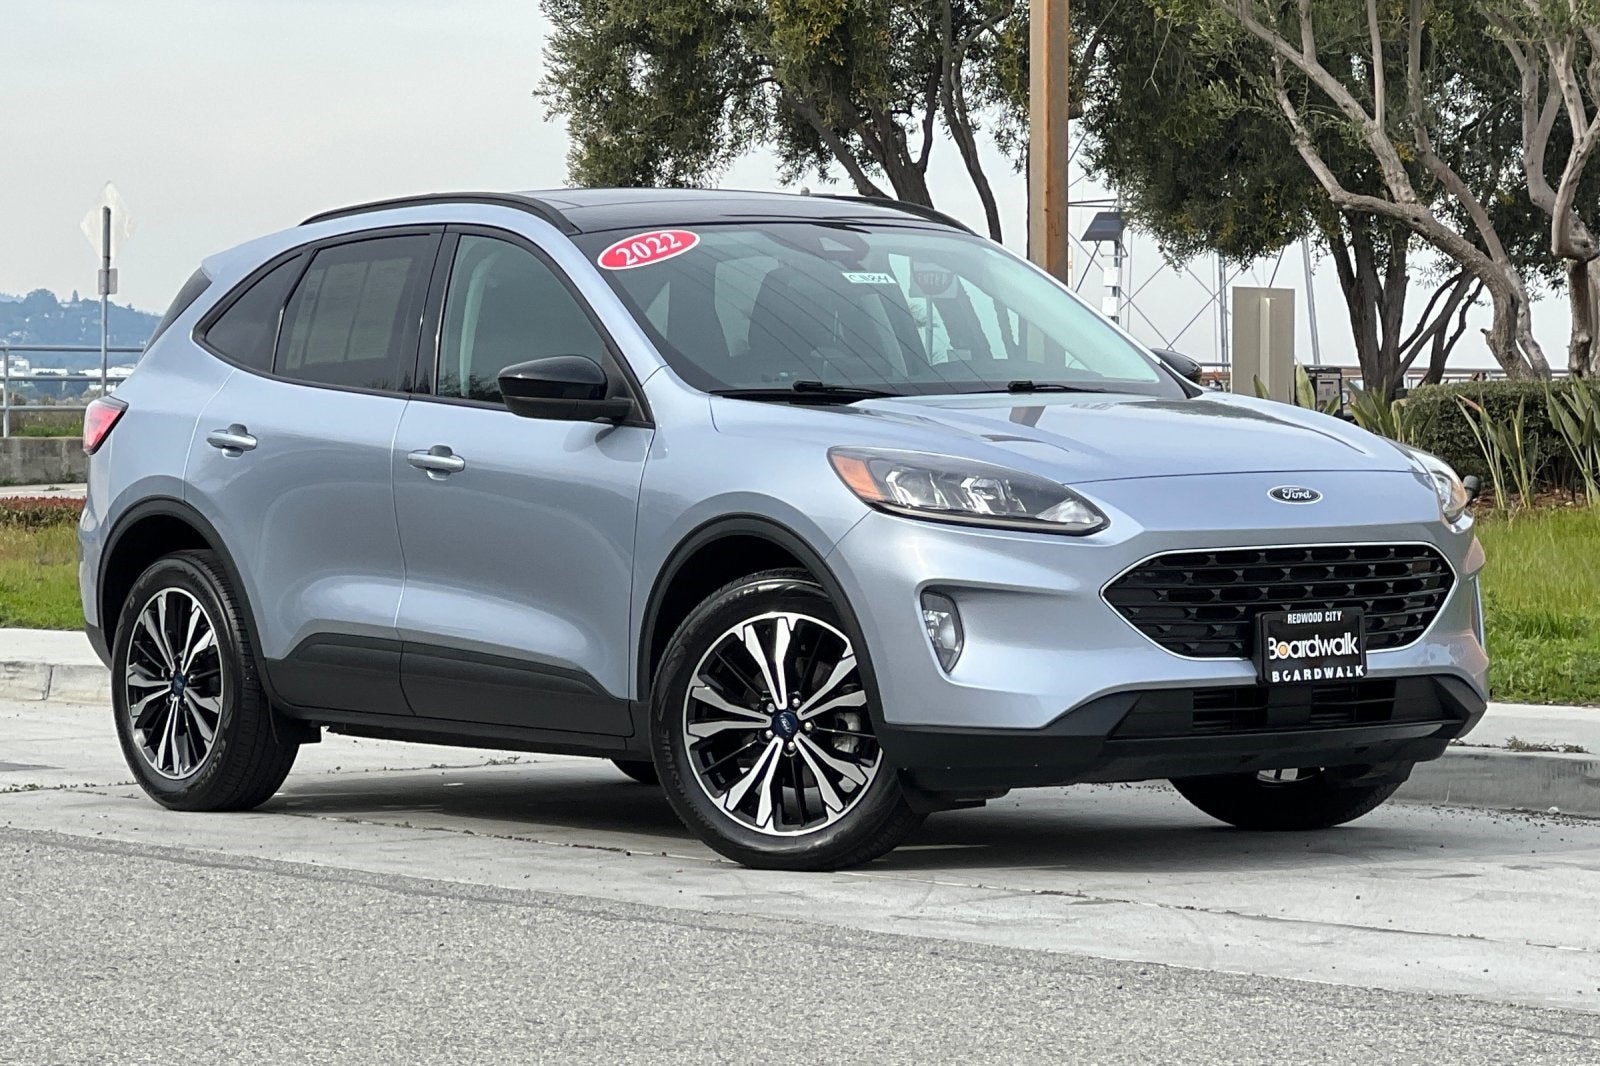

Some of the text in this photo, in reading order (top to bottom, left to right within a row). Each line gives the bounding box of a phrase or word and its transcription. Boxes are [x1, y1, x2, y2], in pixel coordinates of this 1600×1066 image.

[615, 233, 682, 266] 2022
[1282, 488, 1311, 499] Ford
[1287, 610, 1342, 624] REDWOOD CITY
[1268, 632, 1359, 660] Boardwalk
[1272, 665, 1364, 683] BOARDWALK
